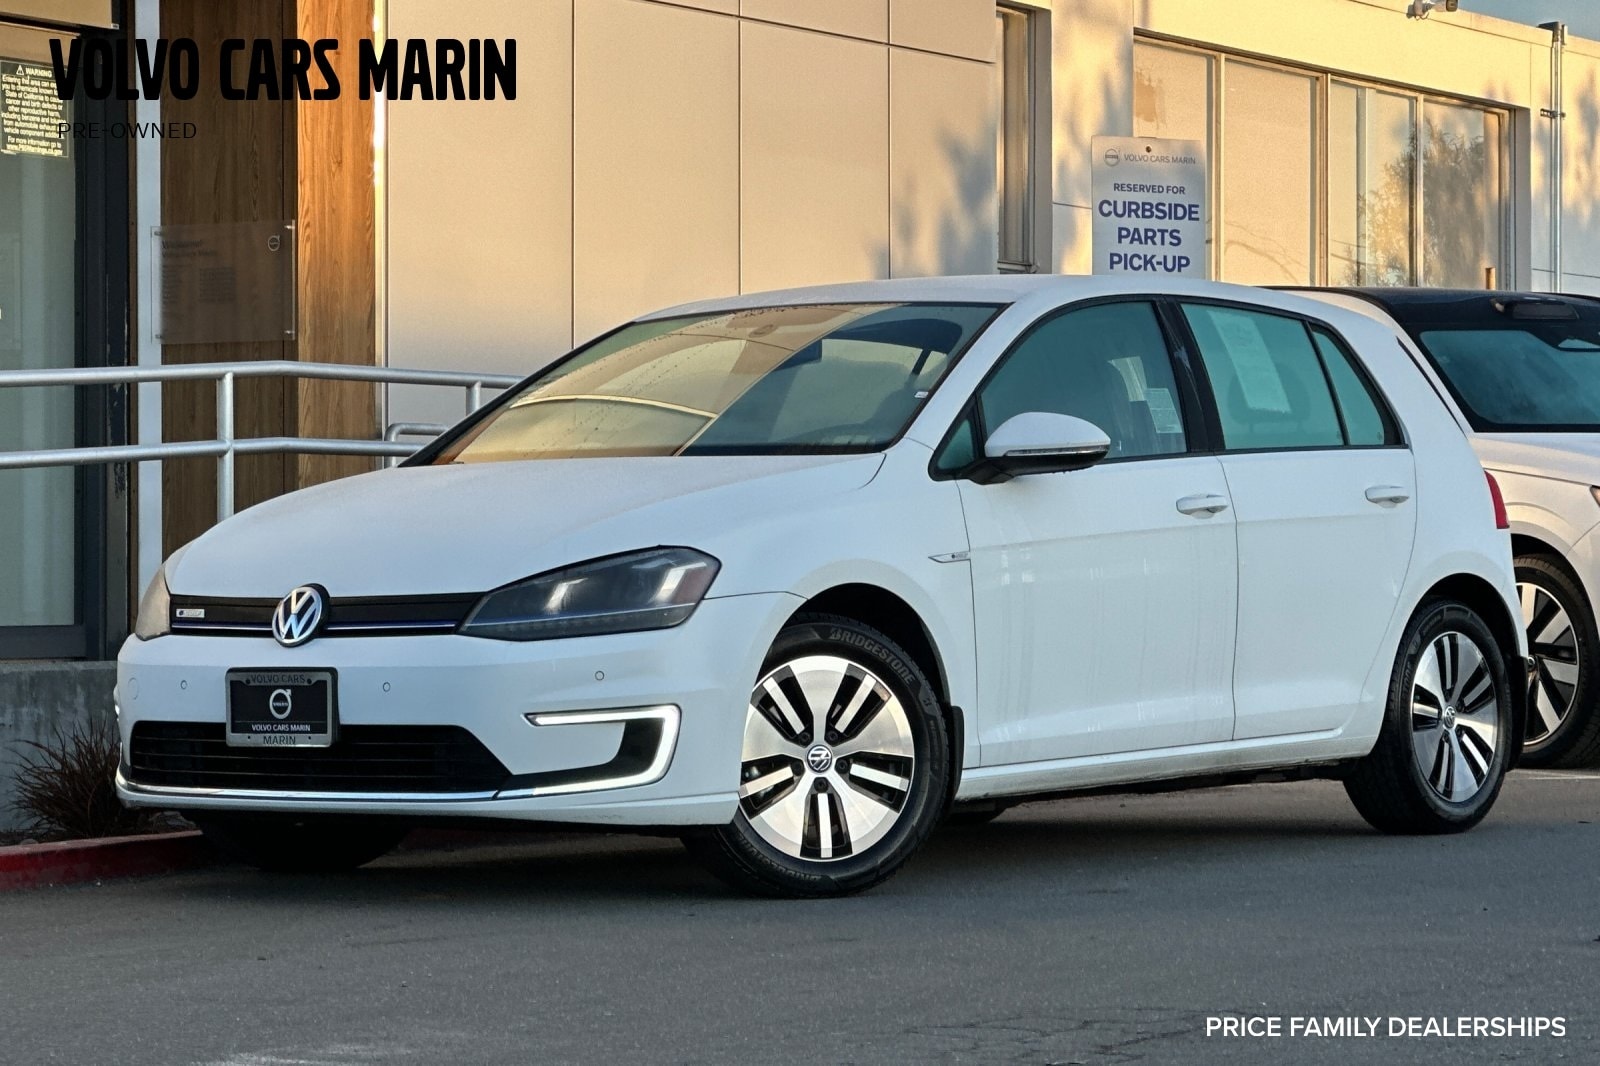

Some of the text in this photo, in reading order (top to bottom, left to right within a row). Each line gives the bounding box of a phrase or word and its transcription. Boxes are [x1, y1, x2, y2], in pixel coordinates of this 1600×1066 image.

[26, 67, 52, 78] WARNING
[1124, 153, 1149, 162] VOLVO
[1149, 155, 1170, 164] CARS
[1171, 156, 1196, 165] MARIN
[1113, 183, 1186, 195] RESERVED FOR
[1098, 199, 1200, 222] CURBSIDE
[1117, 226, 1182, 247] PARTS
[1109, 252, 1191, 273] PICK-UP
[250, 674, 306, 684] VOLVO CARS
[251, 724, 311, 732] VOLVO CARS MARIN
[263, 735, 296, 745] MARIN
